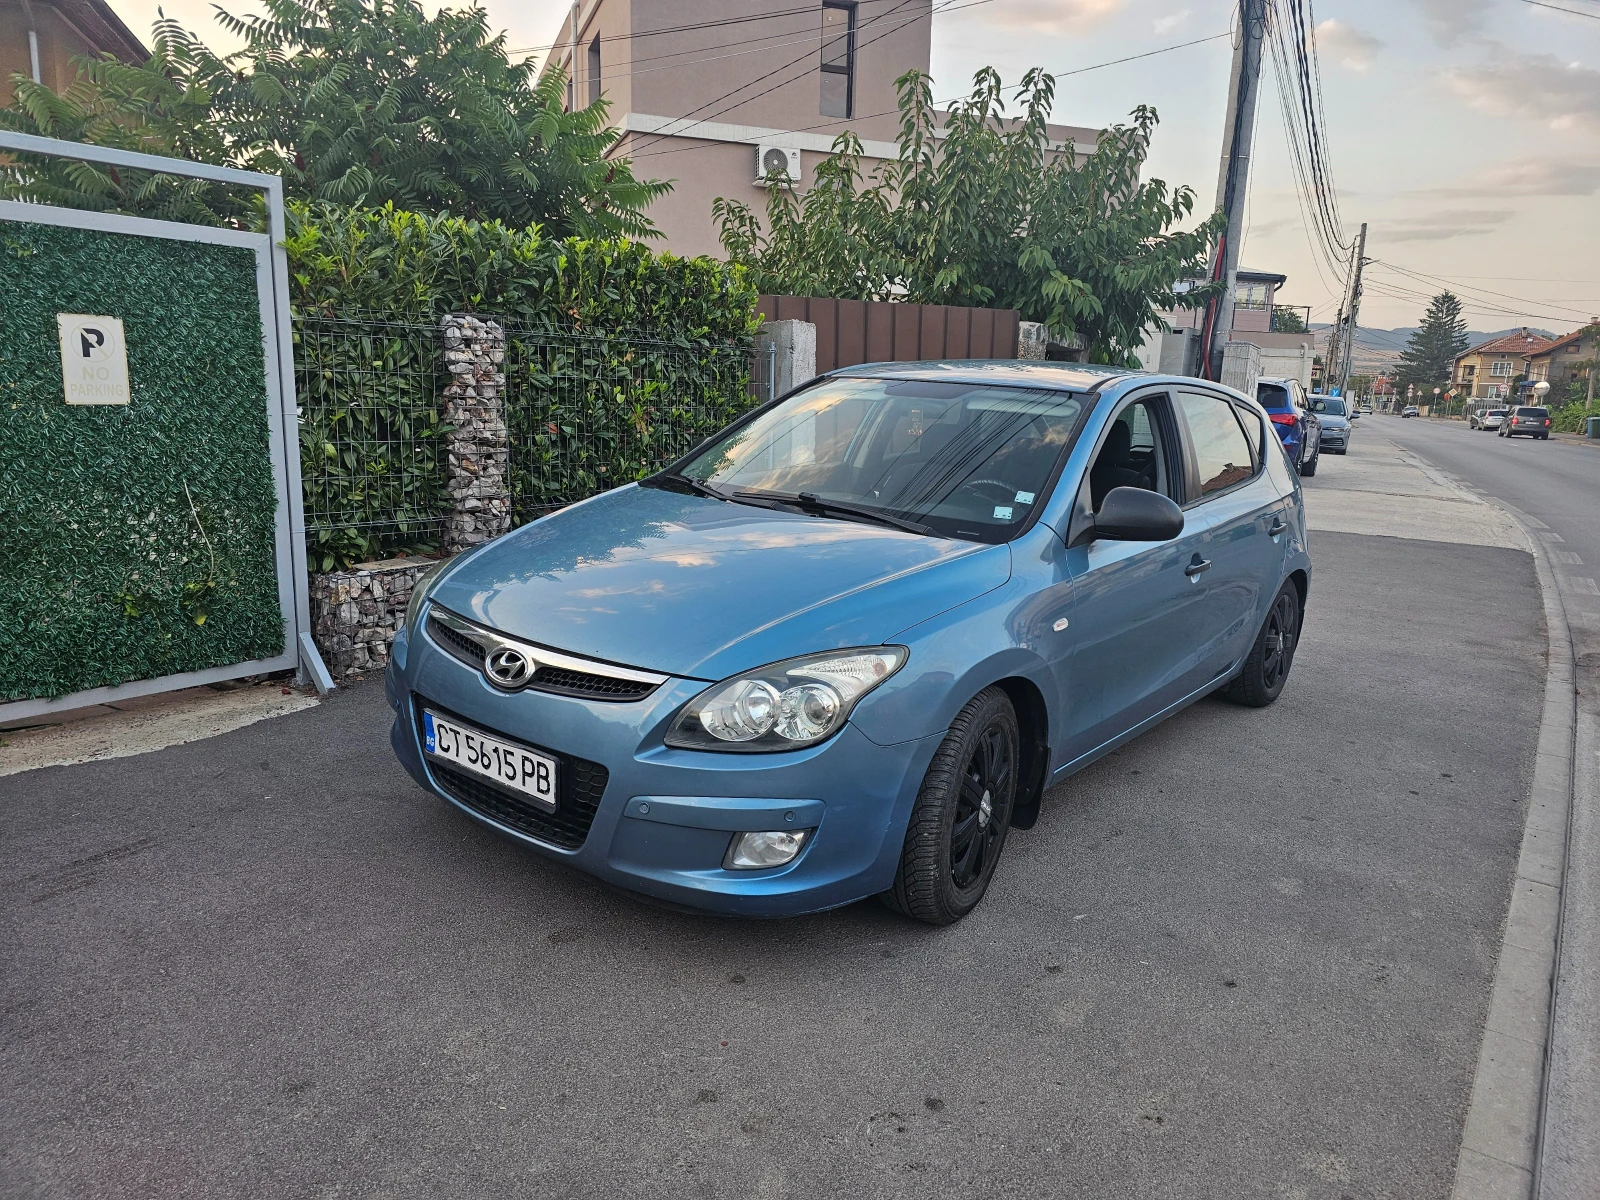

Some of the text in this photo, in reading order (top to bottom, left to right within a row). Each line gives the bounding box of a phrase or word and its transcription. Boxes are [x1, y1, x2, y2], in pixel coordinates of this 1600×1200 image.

[80, 328, 104, 357] P
[82, 366, 110, 380] NO
[70, 383, 124, 397] PARKING
[426, 736, 434, 746] BG
[437, 723, 551, 796] CT 5615 PB
